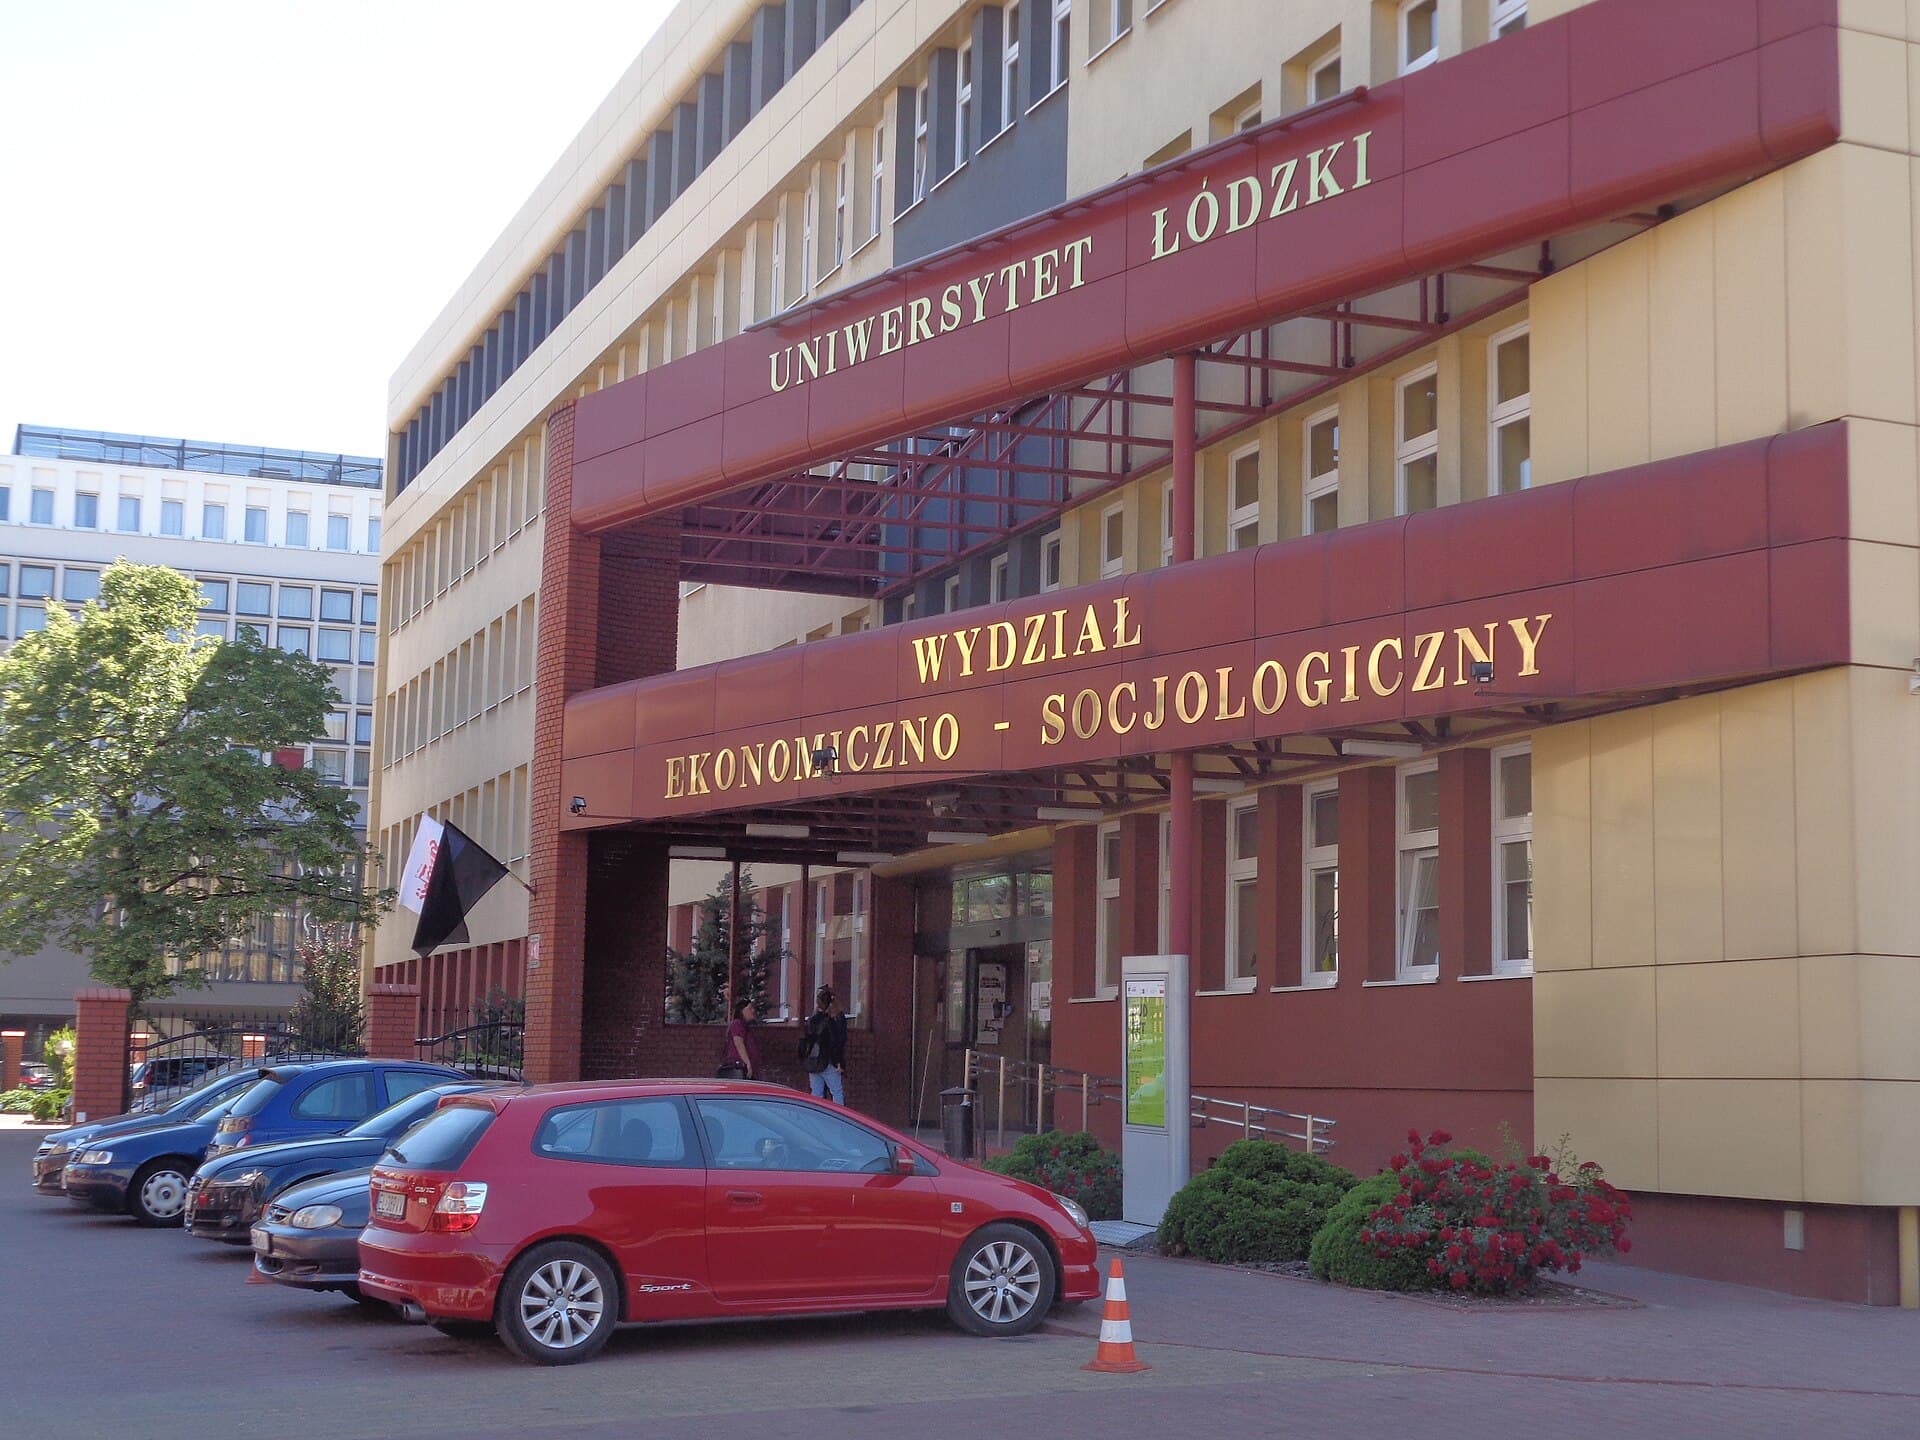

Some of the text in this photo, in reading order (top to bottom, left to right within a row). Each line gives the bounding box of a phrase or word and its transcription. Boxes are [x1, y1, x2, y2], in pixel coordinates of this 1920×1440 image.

[768, 130, 1372, 392] UNIWERSYTET ŁÓDZKI
[664, 713, 960, 799] EKONOMICZNO
[1040, 613, 1553, 745] SOCJOLOGICZNY
[912, 597, 1142, 684] WYDZIAŁ
[639, 1283, 692, 1293] Sport
